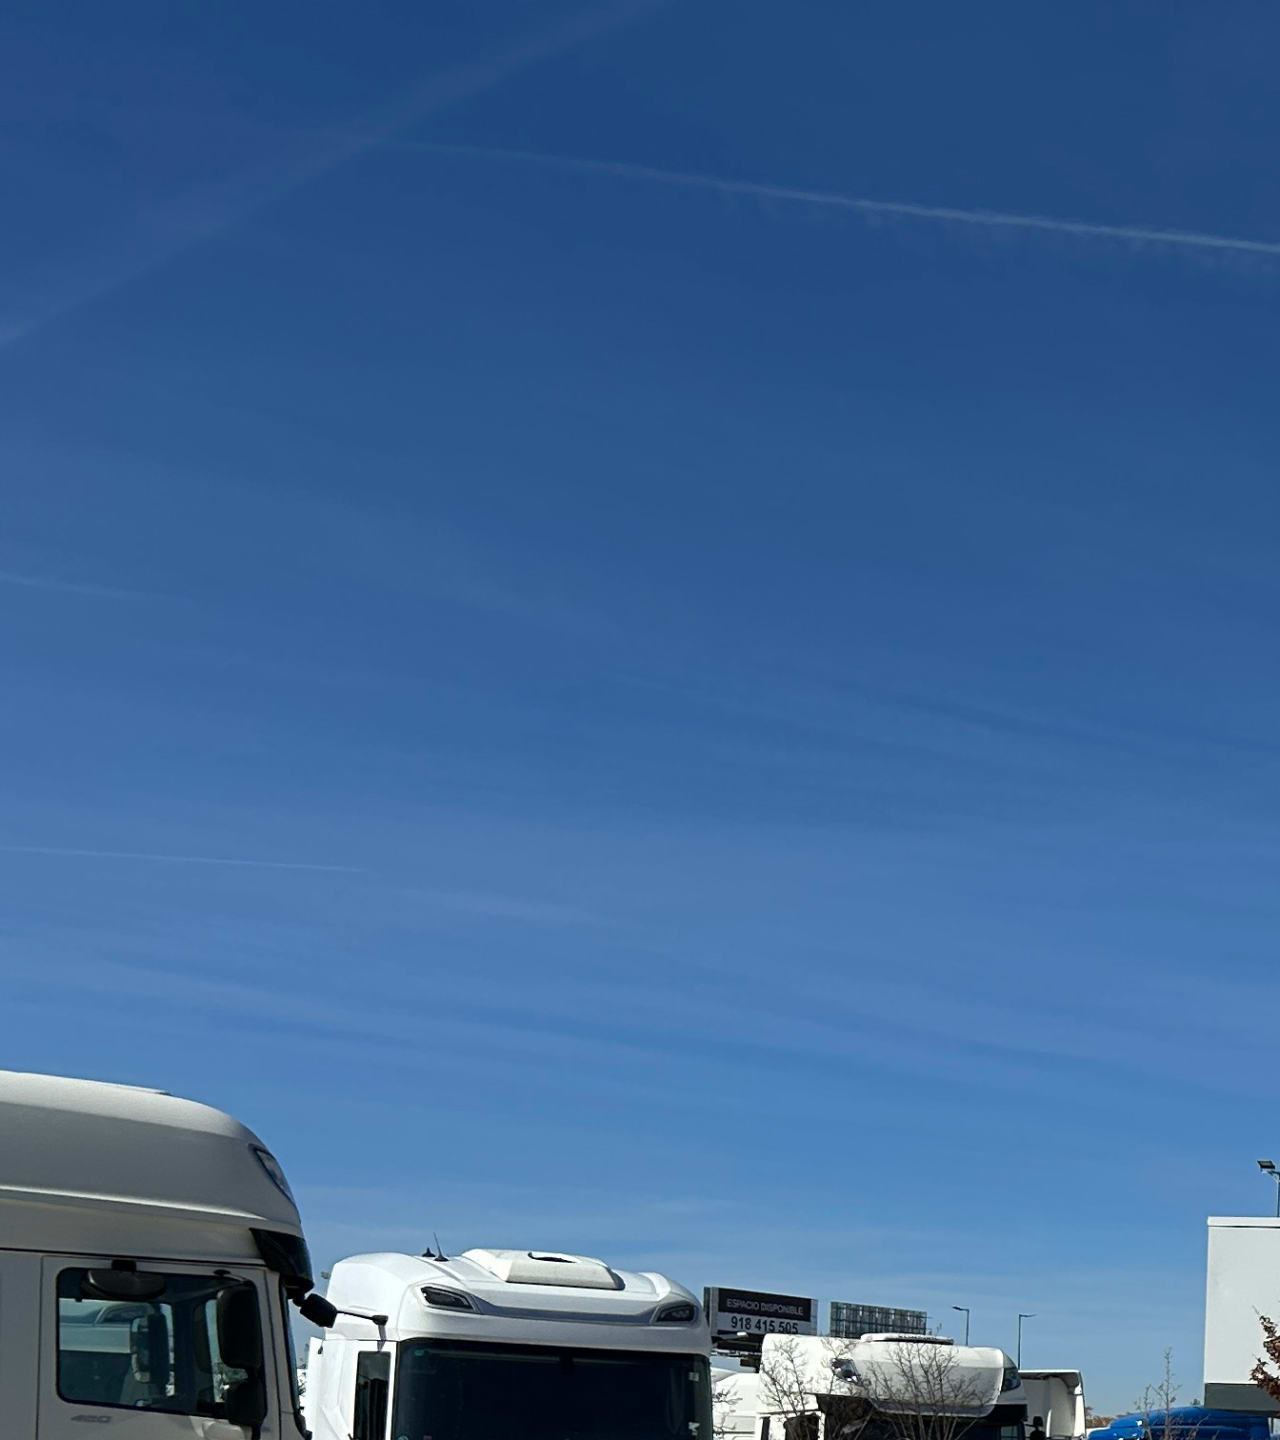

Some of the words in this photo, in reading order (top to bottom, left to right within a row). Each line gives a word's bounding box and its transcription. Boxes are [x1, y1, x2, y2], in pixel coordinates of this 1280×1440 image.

[726, 1298, 759, 1310] ESPACIO
[761, 1302, 804, 1316] DISPONIBLE
[731, 1316, 751, 1330] 918
[755, 1318, 775, 1332] 415
[778, 1321, 799, 1334] 505
